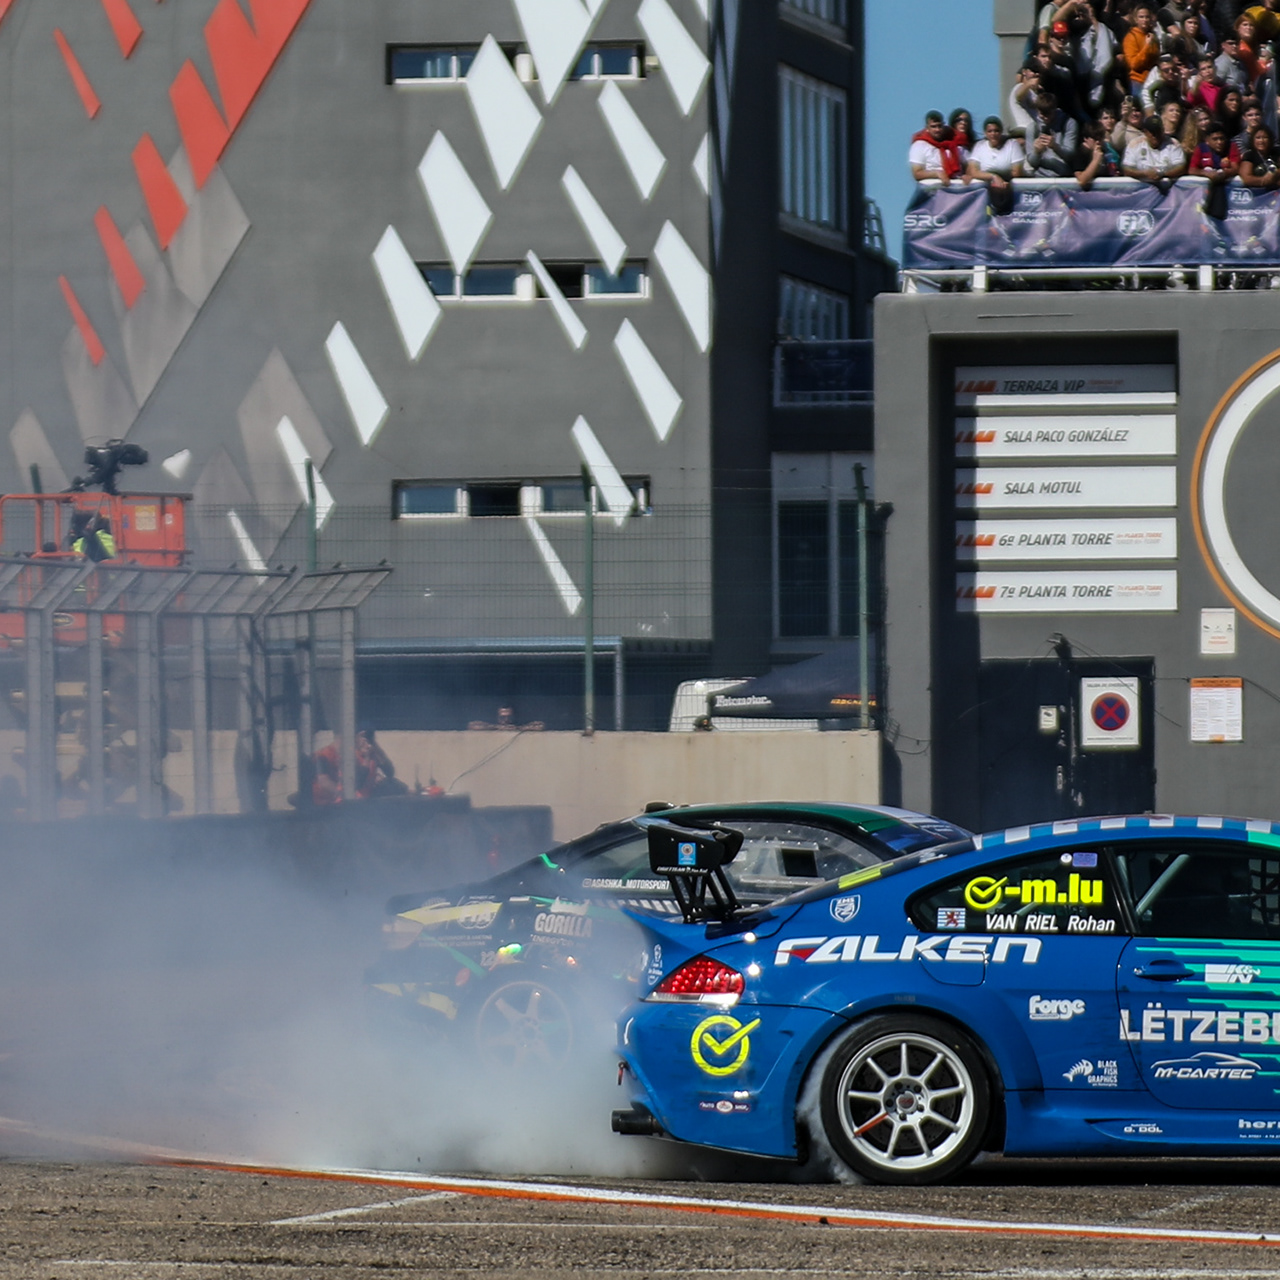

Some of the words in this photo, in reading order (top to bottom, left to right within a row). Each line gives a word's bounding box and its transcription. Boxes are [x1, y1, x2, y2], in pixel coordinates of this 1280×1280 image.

[904, 215, 947, 228] SRC
[1120, 214, 1152, 232] FIA
[1003, 380, 1059, 392] TERRAZA
[1064, 379, 1085, 391] VIP
[1004, 431, 1033, 442] SALA
[1035, 431, 1065, 442] PACO
[1068, 427, 1129, 442] GONZÁLEZ
[1004, 482, 1035, 494] SALA
[1039, 481, 1082, 494] MOTUL
[1018, 534, 1066, 546] PLANTA
[1072, 533, 1114, 545] TORRE
[1018, 586, 1066, 598] PLANTA
[1072, 585, 1114, 597] TORRE
[535, 912, 593, 938] GORILLA
[986, 914, 1017, 930] VAN
[1025, 914, 1059, 931] RIEL
[1068, 915, 1115, 932] Rohan
[774, 935, 1042, 965] FALKEN
[1097, 1060, 1117, 1068] BLACK
[1087, 1075, 1118, 1083] GRAPHICS
[1154, 1067, 1256, 1080] M-CARTEC
